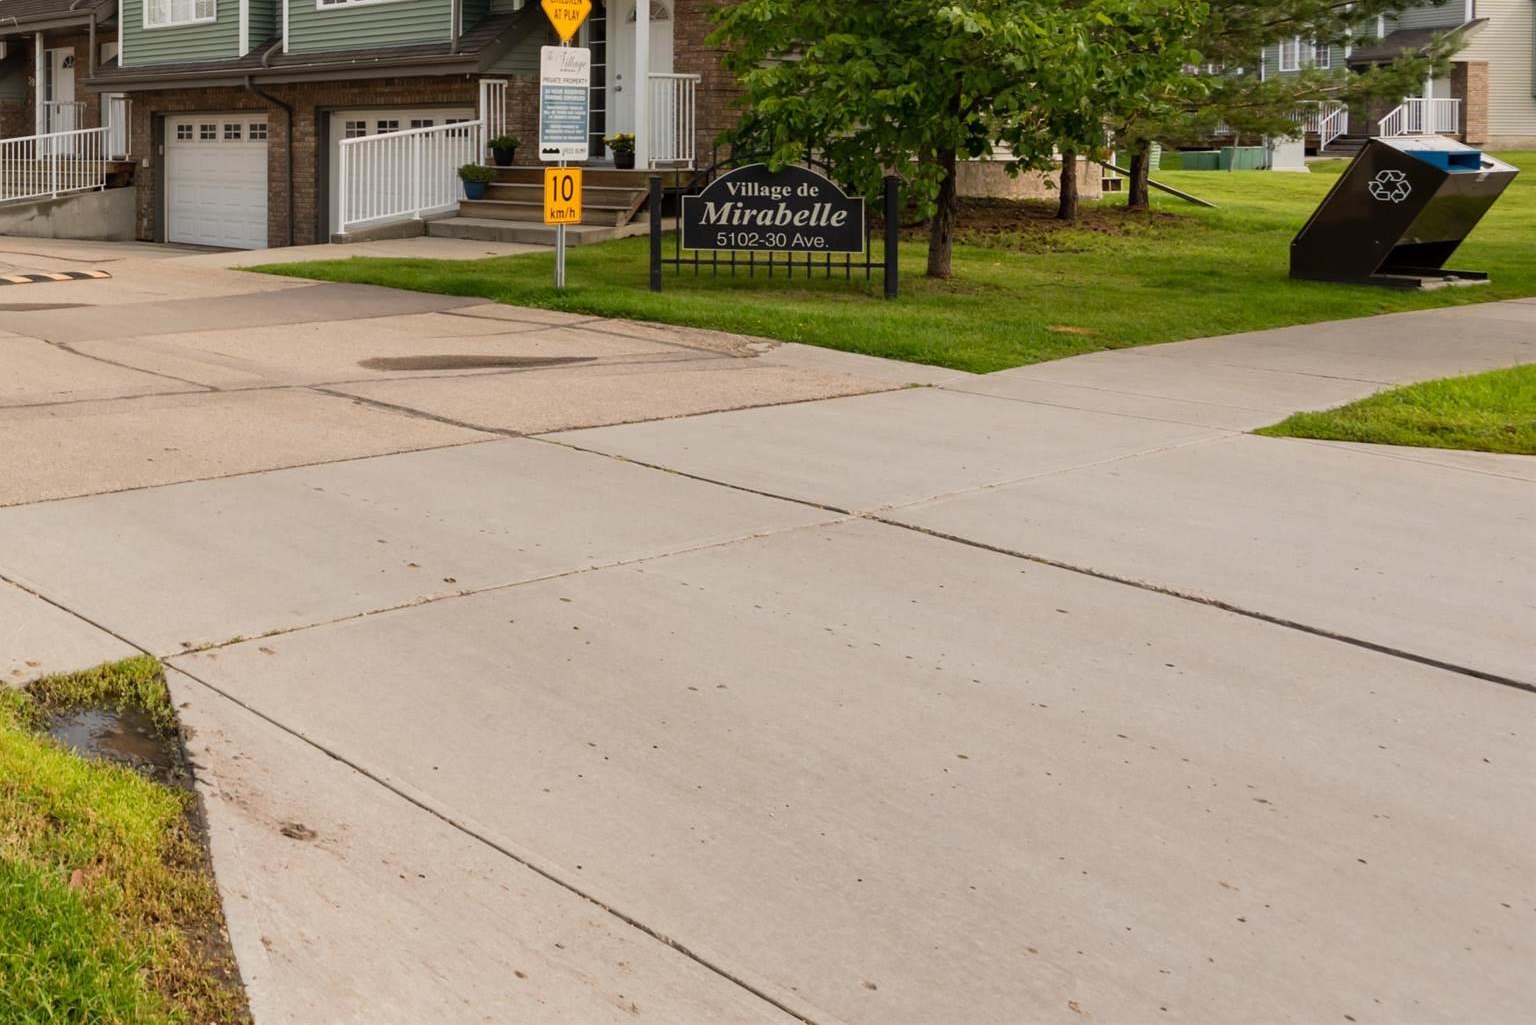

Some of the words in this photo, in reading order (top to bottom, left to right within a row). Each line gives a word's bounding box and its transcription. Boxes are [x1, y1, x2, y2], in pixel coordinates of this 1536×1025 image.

[554, 9, 562, 19] AT
[564, 9, 580, 21] PLAY
[553, 175, 574, 202] 10
[726, 181, 792, 201] Village
[797, 182, 820, 197] de
[550, 207, 576, 219] km/h
[698, 202, 848, 227] Mirabelle
[716, 232, 787, 248] 5102-30
[791, 232, 830, 249] Ave.
